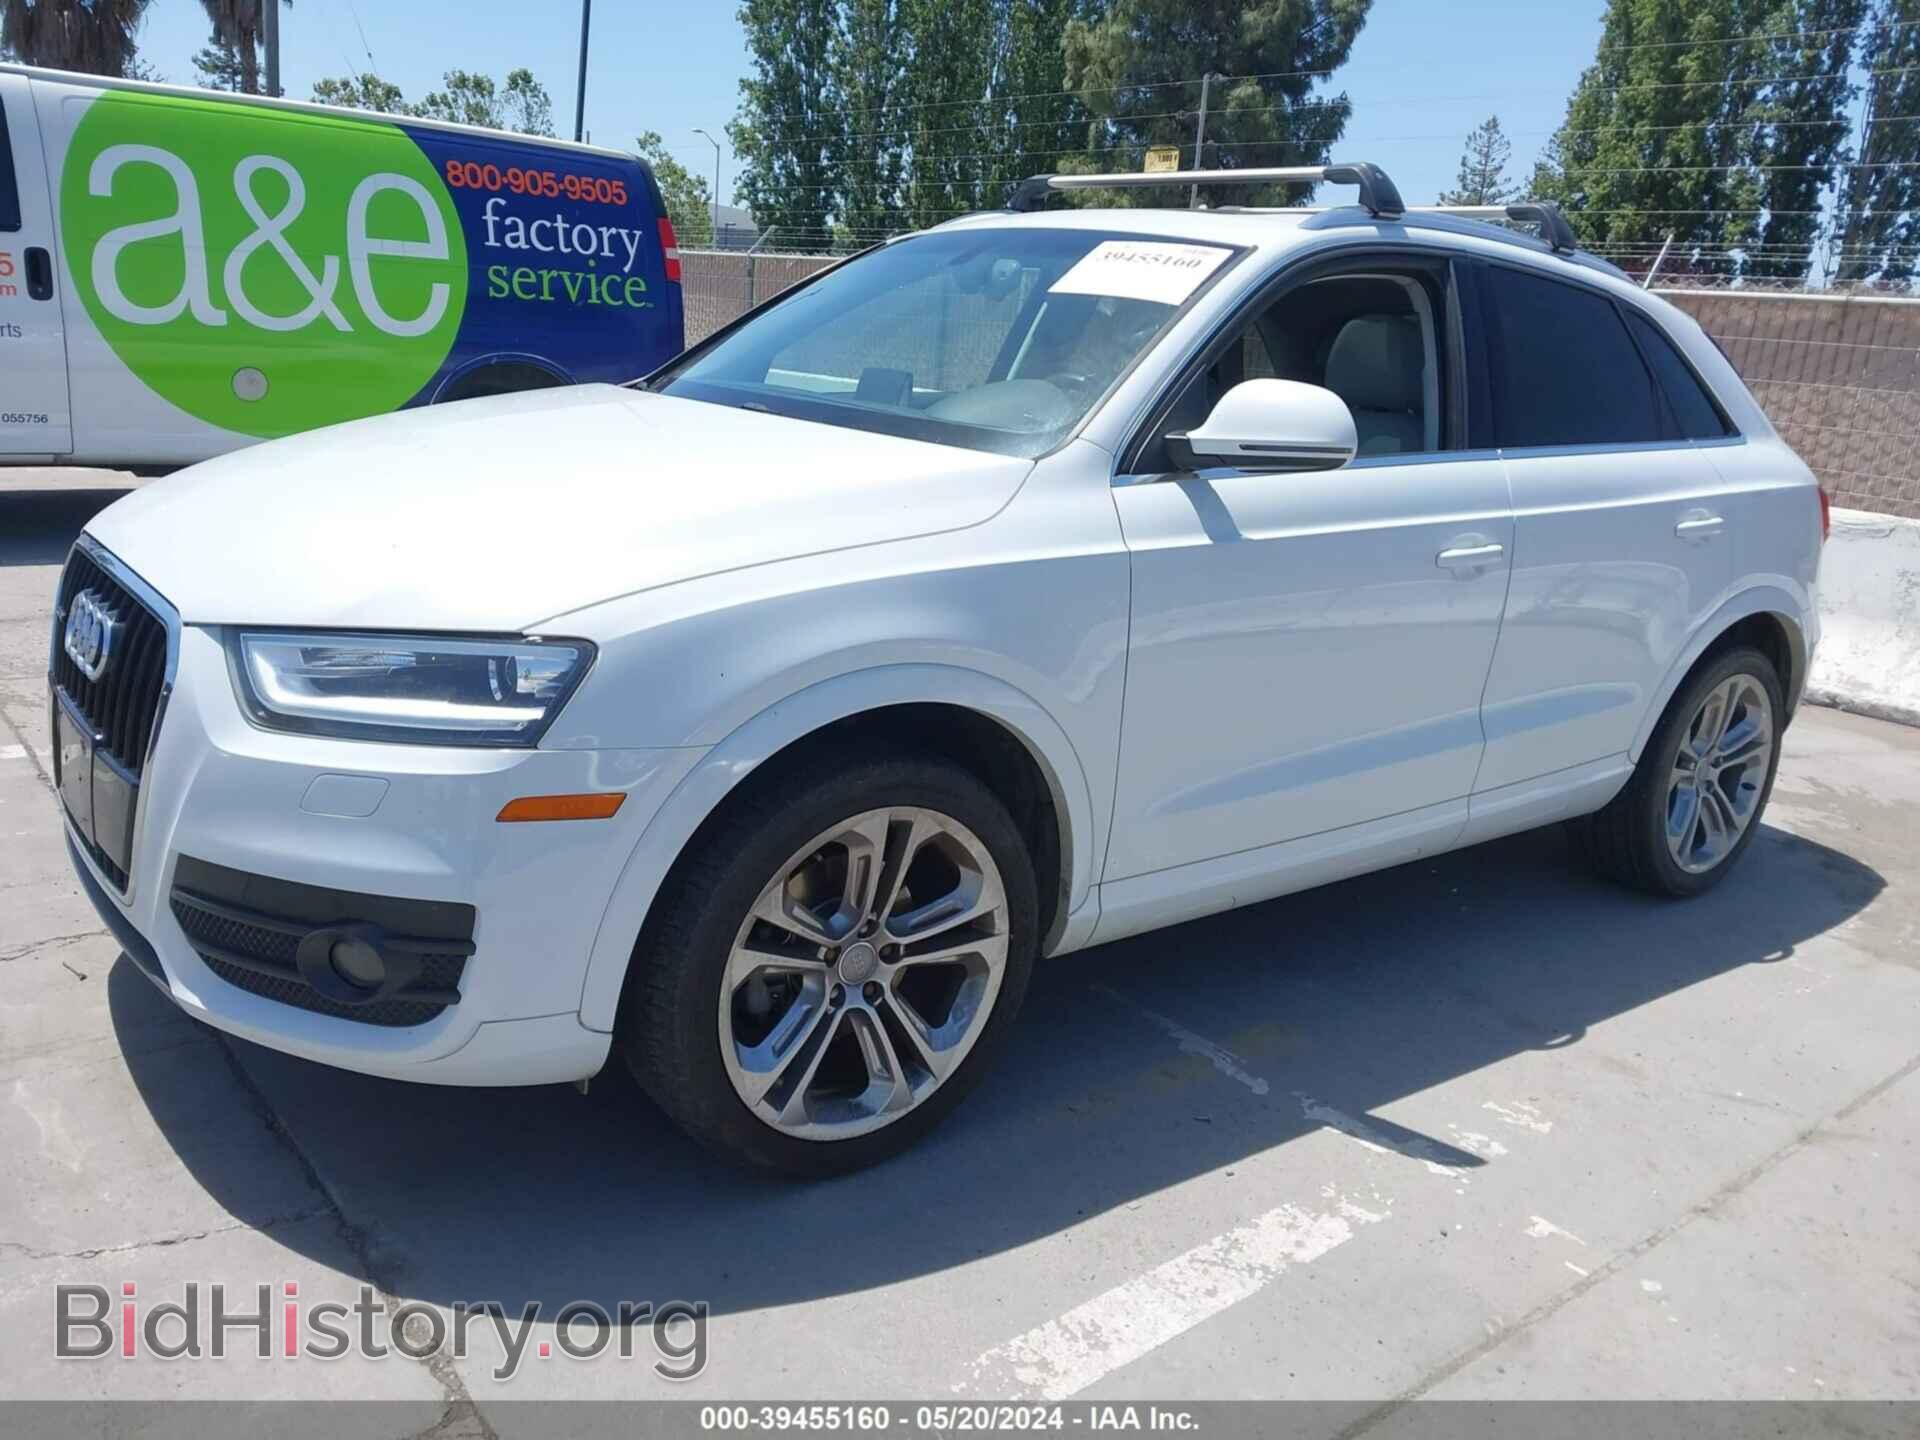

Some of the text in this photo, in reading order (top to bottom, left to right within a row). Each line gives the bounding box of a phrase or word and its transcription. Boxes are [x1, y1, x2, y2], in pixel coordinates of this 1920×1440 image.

[89, 144, 450, 337] a&e
[482, 198, 642, 273] factory
[488, 259, 648, 308] service
